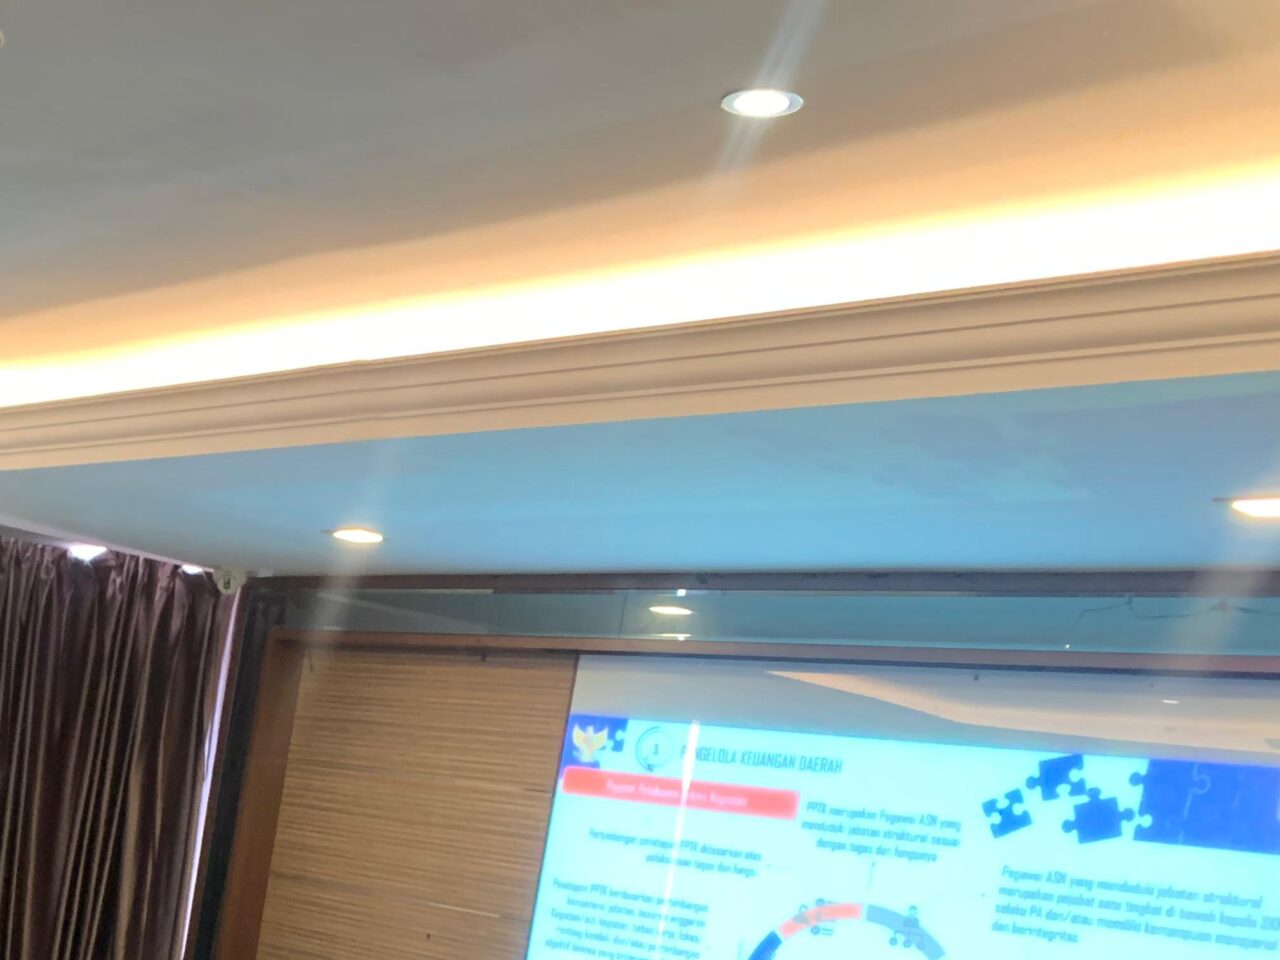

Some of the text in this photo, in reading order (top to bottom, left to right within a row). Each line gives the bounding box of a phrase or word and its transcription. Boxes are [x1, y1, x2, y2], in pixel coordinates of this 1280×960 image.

[681, 745, 737, 764] PNGELOLA
[740, 750, 796, 769] KEUANGAN
[798, 755, 843, 774] DAERAH
[1046, 871, 1068, 884] ASN
